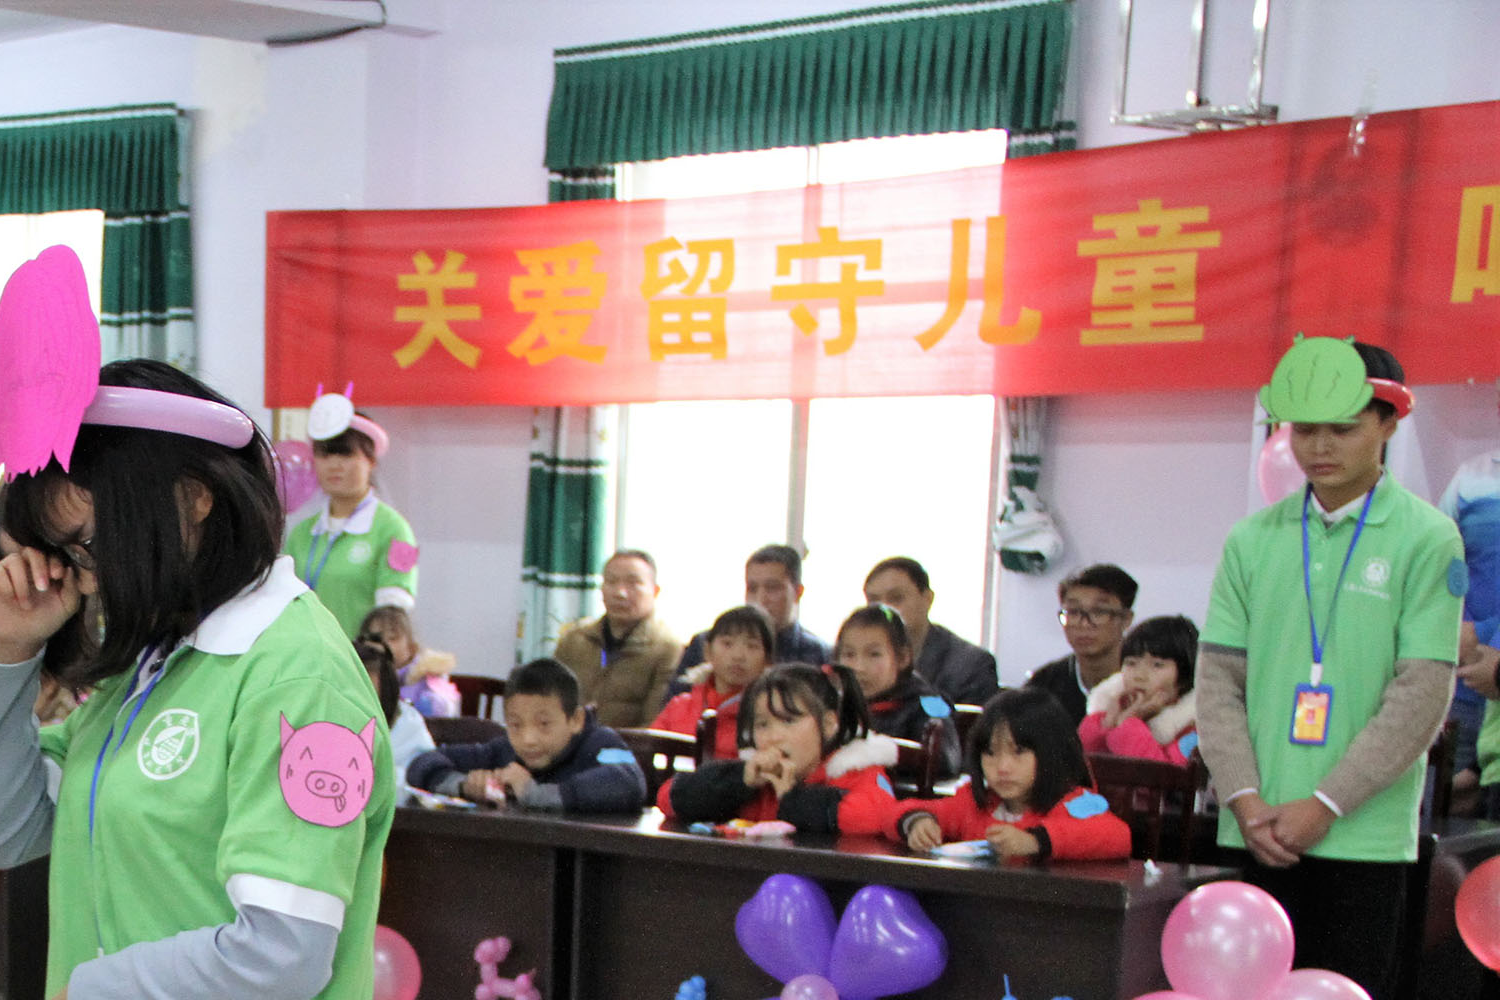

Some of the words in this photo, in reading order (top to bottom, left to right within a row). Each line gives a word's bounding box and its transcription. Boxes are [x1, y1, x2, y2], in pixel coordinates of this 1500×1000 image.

[392, 198, 1221, 369] 关爱留守儿童
